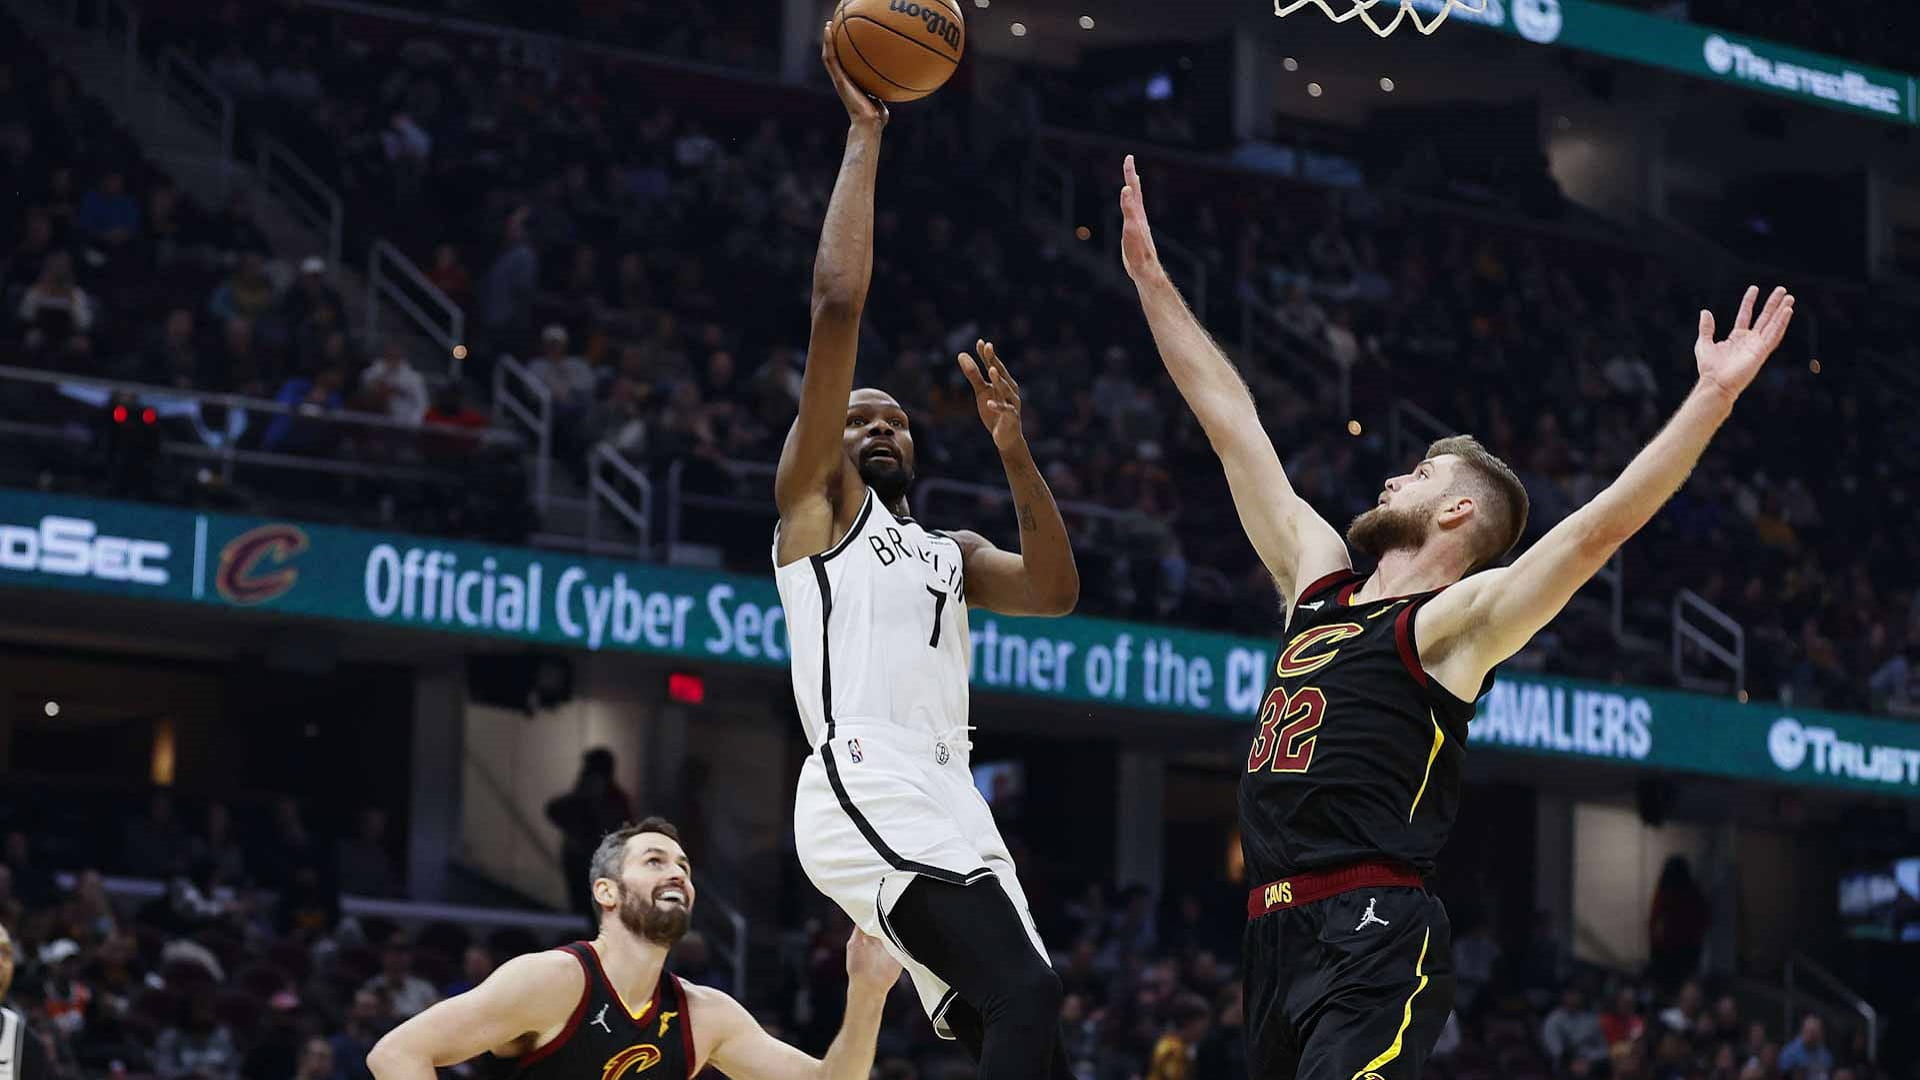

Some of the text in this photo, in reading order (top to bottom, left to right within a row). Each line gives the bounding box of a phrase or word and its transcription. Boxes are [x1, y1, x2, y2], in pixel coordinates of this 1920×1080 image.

[889, 0, 960, 52] Wilson
[365, 543, 543, 632] Official
[555, 566, 696, 651] Cyber
[704, 583, 791, 660] Sec
[1085, 631, 1134, 698] of
[1143, 638, 1214, 709] the
[926, 584, 947, 649] 7
[1277, 622, 1364, 678] C
[1247, 686, 1327, 773] 32
[1264, 881, 1293, 909] CAVS
